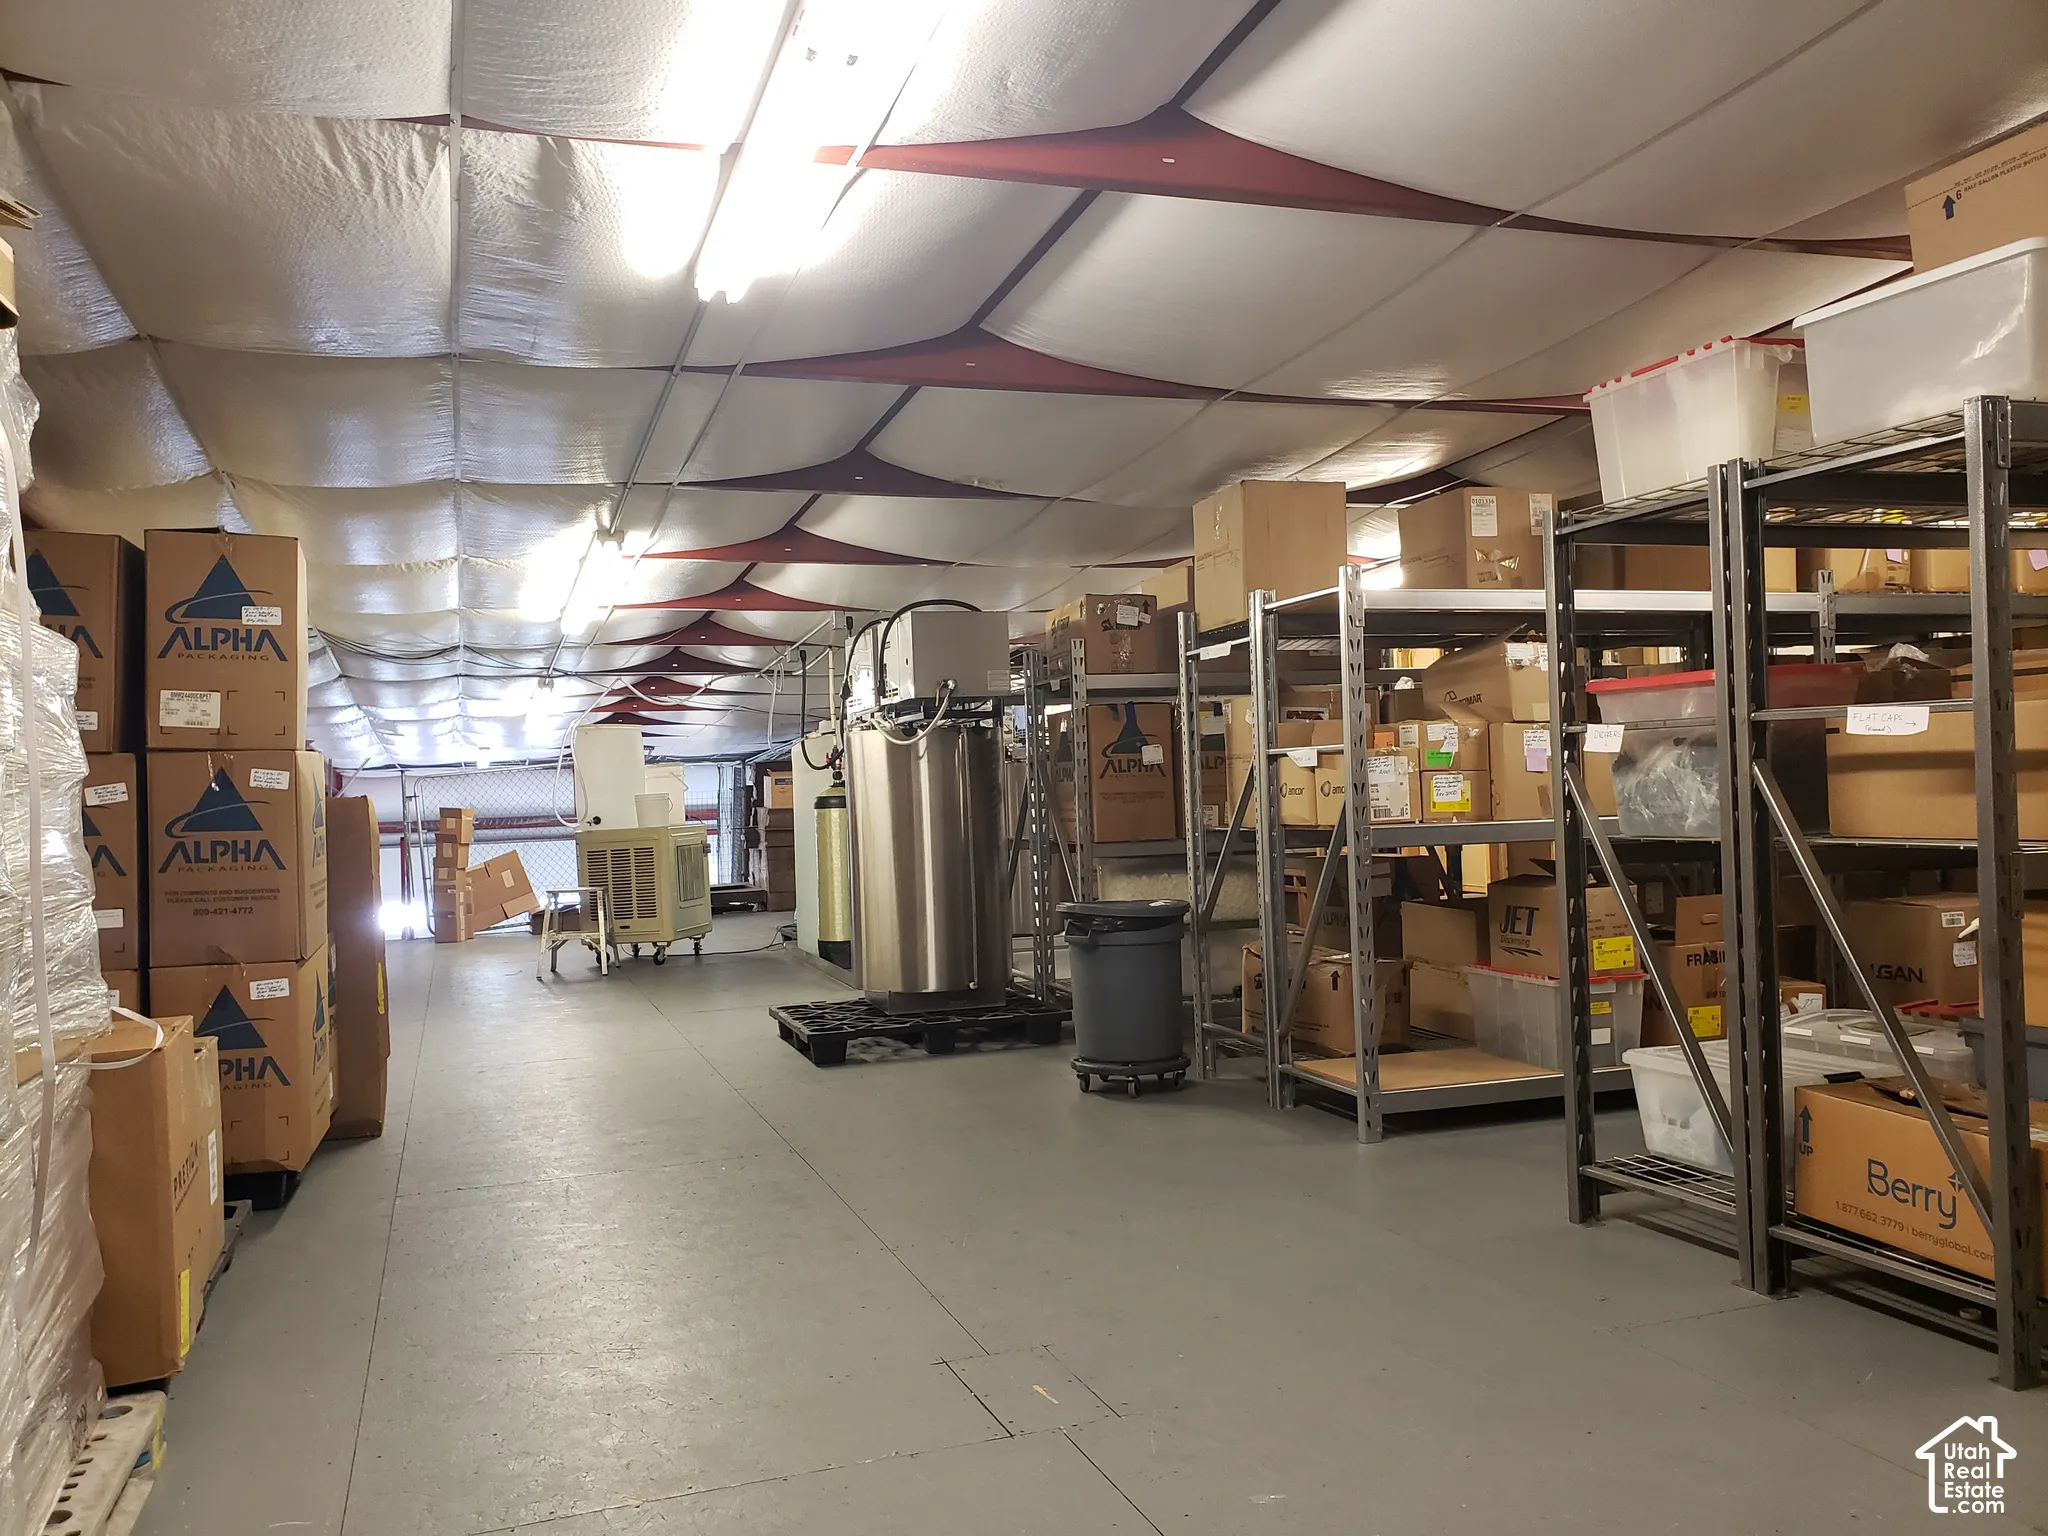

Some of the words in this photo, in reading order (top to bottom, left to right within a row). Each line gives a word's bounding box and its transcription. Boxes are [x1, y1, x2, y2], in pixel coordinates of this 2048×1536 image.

[1956, 190, 1962, 200] 6
[1978, 174, 1999, 185] GALLON
[2000, 163, 2021, 176] PLASTIC
[157, 626, 288, 662] ALPHA
[177, 652, 269, 662] PACKAGING
[1853, 713, 1878, 722] FLAT
[1881, 713, 1903, 722] CAPS
[1099, 758, 1166, 780] ALPHA
[1288, 787, 1305, 796] amcor
[1332, 786, 1345, 795] amc
[157, 839, 287, 874] ALPHA
[177, 864, 269, 874] PACKAGING
[1499, 904, 1540, 937] JET
[218, 1055, 291, 1087] PHA
[223, 1082, 272, 1091] AGING
[1799, 1142, 1814, 1157] UP
[1867, 1158, 1957, 1230] Berry
[1835, 1200, 1904, 1232] 1.877.662.3779
